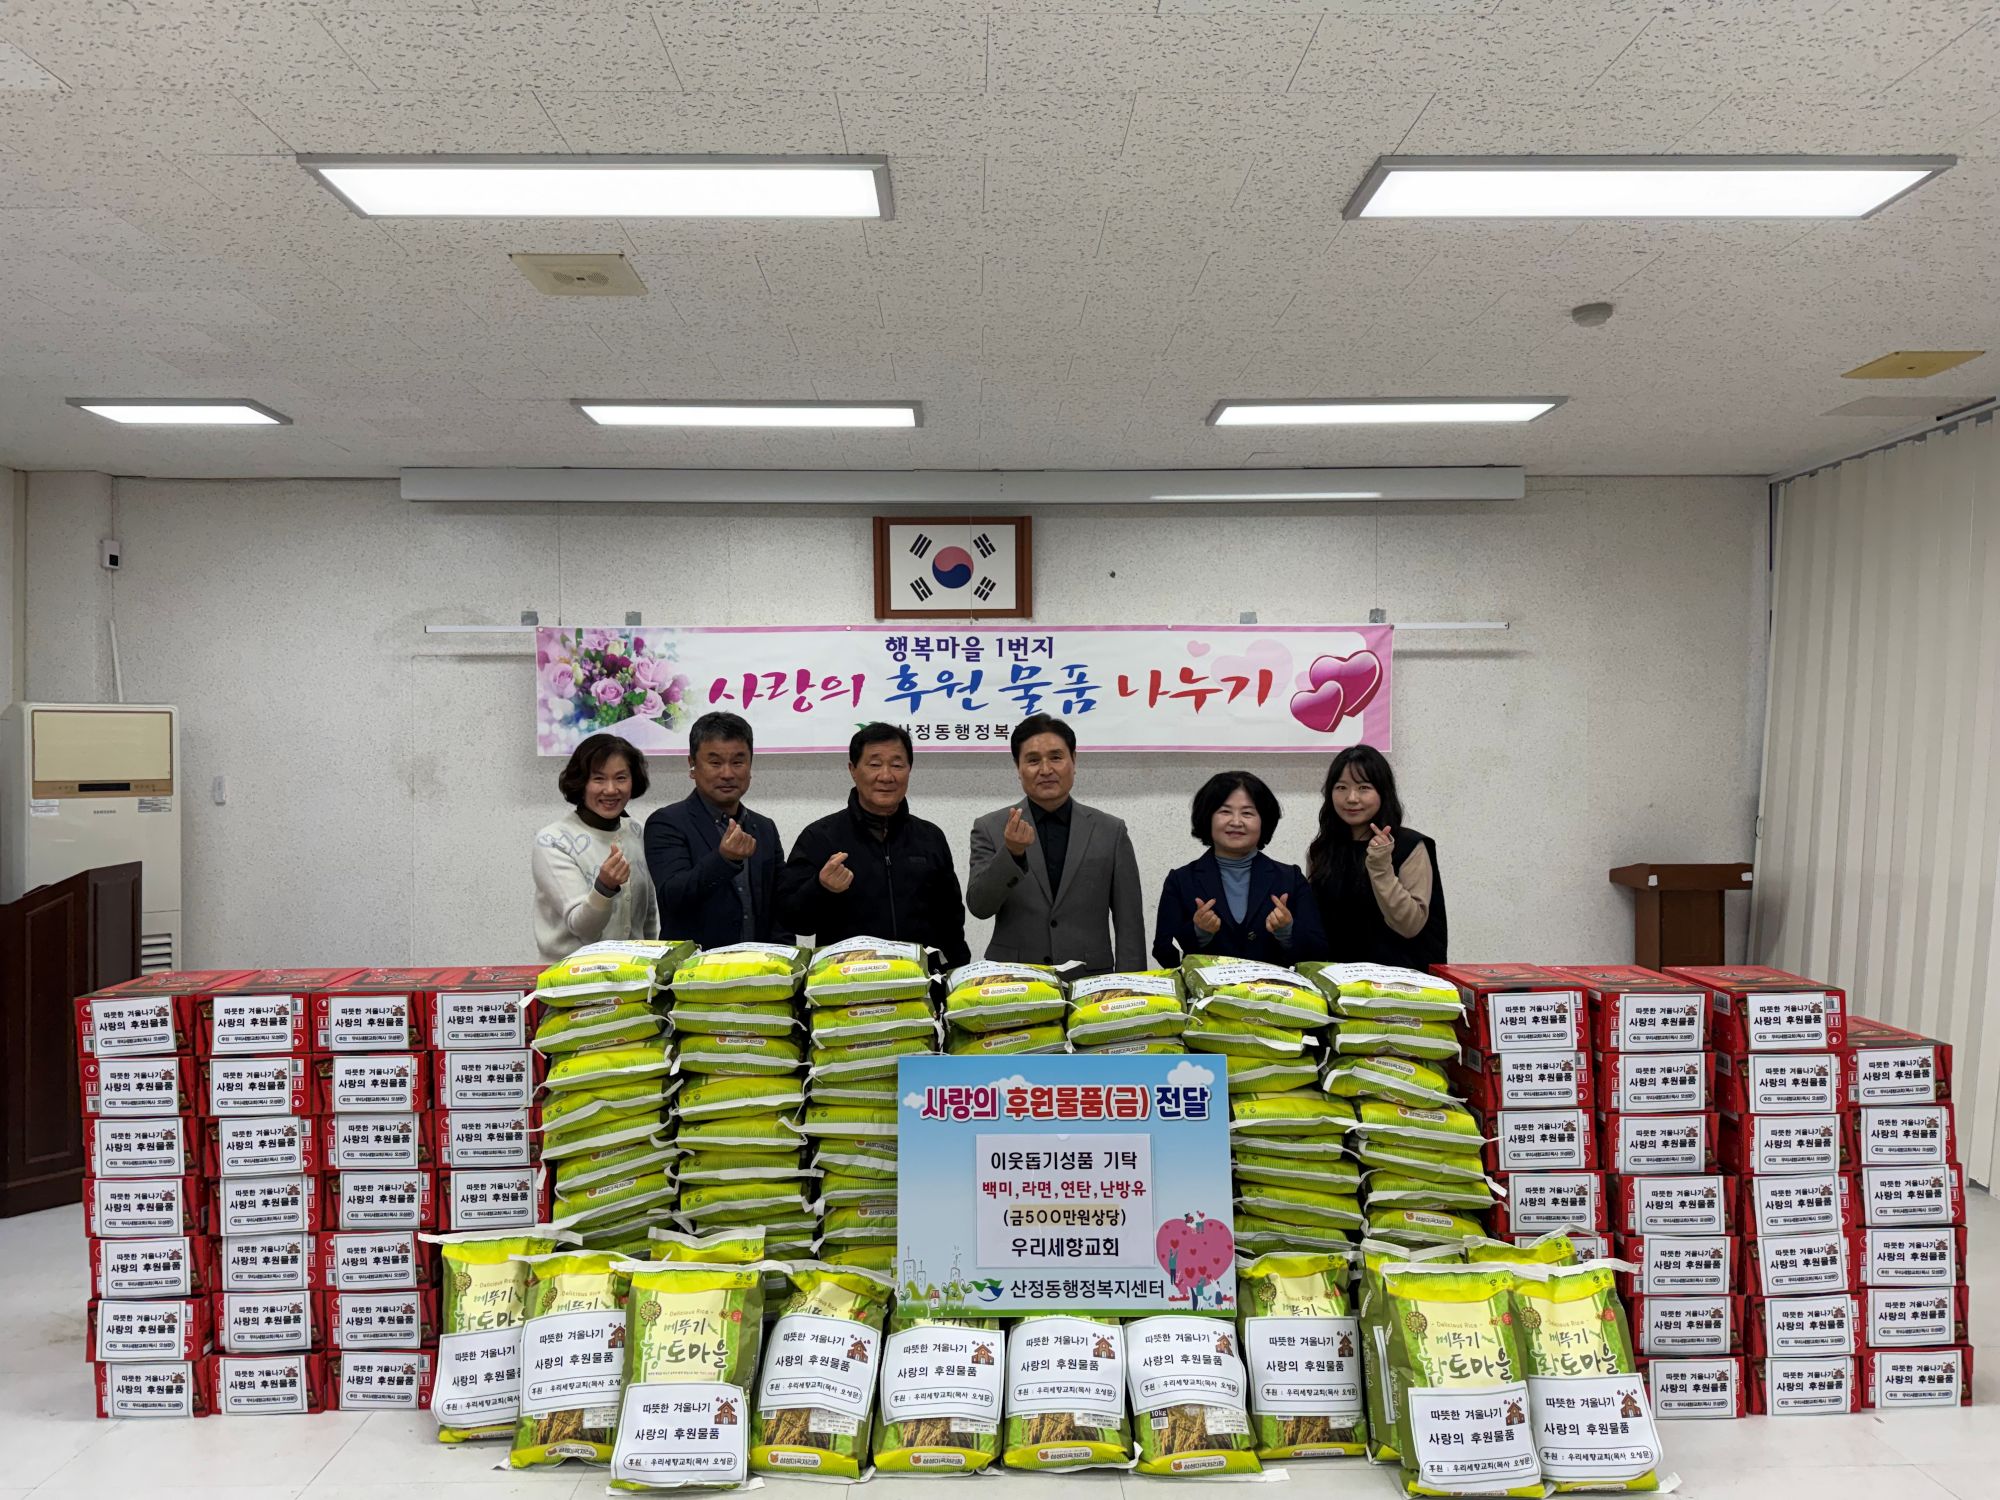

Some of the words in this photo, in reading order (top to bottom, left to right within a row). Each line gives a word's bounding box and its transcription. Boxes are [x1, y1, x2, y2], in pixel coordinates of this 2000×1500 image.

[885, 636, 986, 664] 행복마을
[997, 636, 1055, 664] 1번지
[708, 668, 865, 711] 사랑의
[885, 664, 988, 714] 후원
[1000, 662, 1101, 717] 물품
[1118, 668, 1274, 712] 나누기
[218, 1018, 244, 1027] 사랑의
[250, 1017, 287, 1027] 후원물품
[448, 1016, 473, 1024] 사랑의
[479, 1014, 516, 1024] 후원물품
[1500, 1016, 1526, 1025] 사랑의
[1532, 1015, 1566, 1024] 후원물품
[1754, 1016, 1781, 1025] 사랑의
[1786, 1015, 1821, 1024] 후원물품
[922, 1088, 997, 1118] 사랑의
[1006, 1088, 1150, 1118] 후원물품(금)
[1156, 1088, 1208, 1118] 전달
[106, 1143, 131, 1152] 사랑의
[137, 1141, 174, 1151] 후원물품
[991, 1152, 1093, 1170] 이웃돕기성품
[1104, 1152, 1137, 1169] 기탁
[983, 1181, 1146, 1199] 백미,라면,연탄,난방유
[1004, 1209, 1126, 1226] (금500만원상당)
[1012, 1238, 1118, 1257] 우리세향교회
[1010, 1280, 1164, 1298] 산정동행정복지센터
[663, 1317, 706, 1335] 메뚜기
[540, 1332, 563, 1344] 따뜻한
[568, 1329, 603, 1340] 겨울나기
[783, 1332, 806, 1342] 따뜻한
[810, 1335, 844, 1346] 겨울나기
[1026, 1336, 1049, 1347] 따뜻한
[1054, 1336, 1088, 1346] 겨울나기
[1145, 1334, 1170, 1343] 따뜻한
[1176, 1334, 1209, 1342] 겨울나기
[1269, 1337, 1296, 1346] 따뜻한
[1300, 1337, 1334, 1347] 겨울나기
[1436, 1331, 1480, 1349] 메뚜기
[1549, 1328, 1588, 1348] 메뚜기
[455, 1351, 476, 1362] 따뜻한
[481, 1345, 515, 1358] 겨울나기
[642, 1338, 729, 1369] 황토마을
[904, 1344, 928, 1354] 따뜻한
[933, 1344, 967, 1353] 겨울나기
[535, 1356, 563, 1370] 사랑의
[570, 1352, 614, 1365] 후원물품
[775, 1355, 803, 1367] 사랑의
[808, 1353, 852, 1372] 후원물품
[1021, 1359, 1049, 1372] 사랑의
[1057, 1359, 1099, 1371] 후원물품
[1143, 1354, 1173, 1367] 사랑의
[1181, 1353, 1224, 1366] 후원물품
[1266, 1361, 1298, 1372] 사랑의
[1305, 1360, 1344, 1372] 후원물품
[1418, 1347, 1512, 1384] 황토마을
[897, 1366, 928, 1378] 사랑의
[934, 1365, 977, 1377] 후원물품
[347, 1376, 372, 1385] 사랑의
[378, 1374, 414, 1385] 후원물품
[452, 1374, 477, 1387] 사랑의
[1885, 1375, 1912, 1384] 사랑의
[1918, 1375, 1953, 1384] 후원물품
[532, 1387, 542, 1395] 후원
[1018, 1388, 1028, 1396] 후원
[1145, 1383, 1155, 1391] 후원
[643, 1403, 669, 1414] 따뜻한
[674, 1403, 710, 1412] 겨울나기
[1546, 1398, 1575, 1408] 따뜻한
[1580, 1397, 1615, 1408] 겨울나기
[1431, 1410, 1460, 1420] 따뜻한
[1465, 1408, 1502, 1420] 겨울나기
[635, 1428, 667, 1440] 사랑의
[674, 1428, 719, 1440] 후원물품
[1544, 1423, 1579, 1435] 사랑의
[1587, 1422, 1629, 1435] 후원물품
[1429, 1433, 1464, 1445] 사랑의
[1471, 1429, 1514, 1444] 후원물품
[1544, 1452, 1557, 1460] 후원
